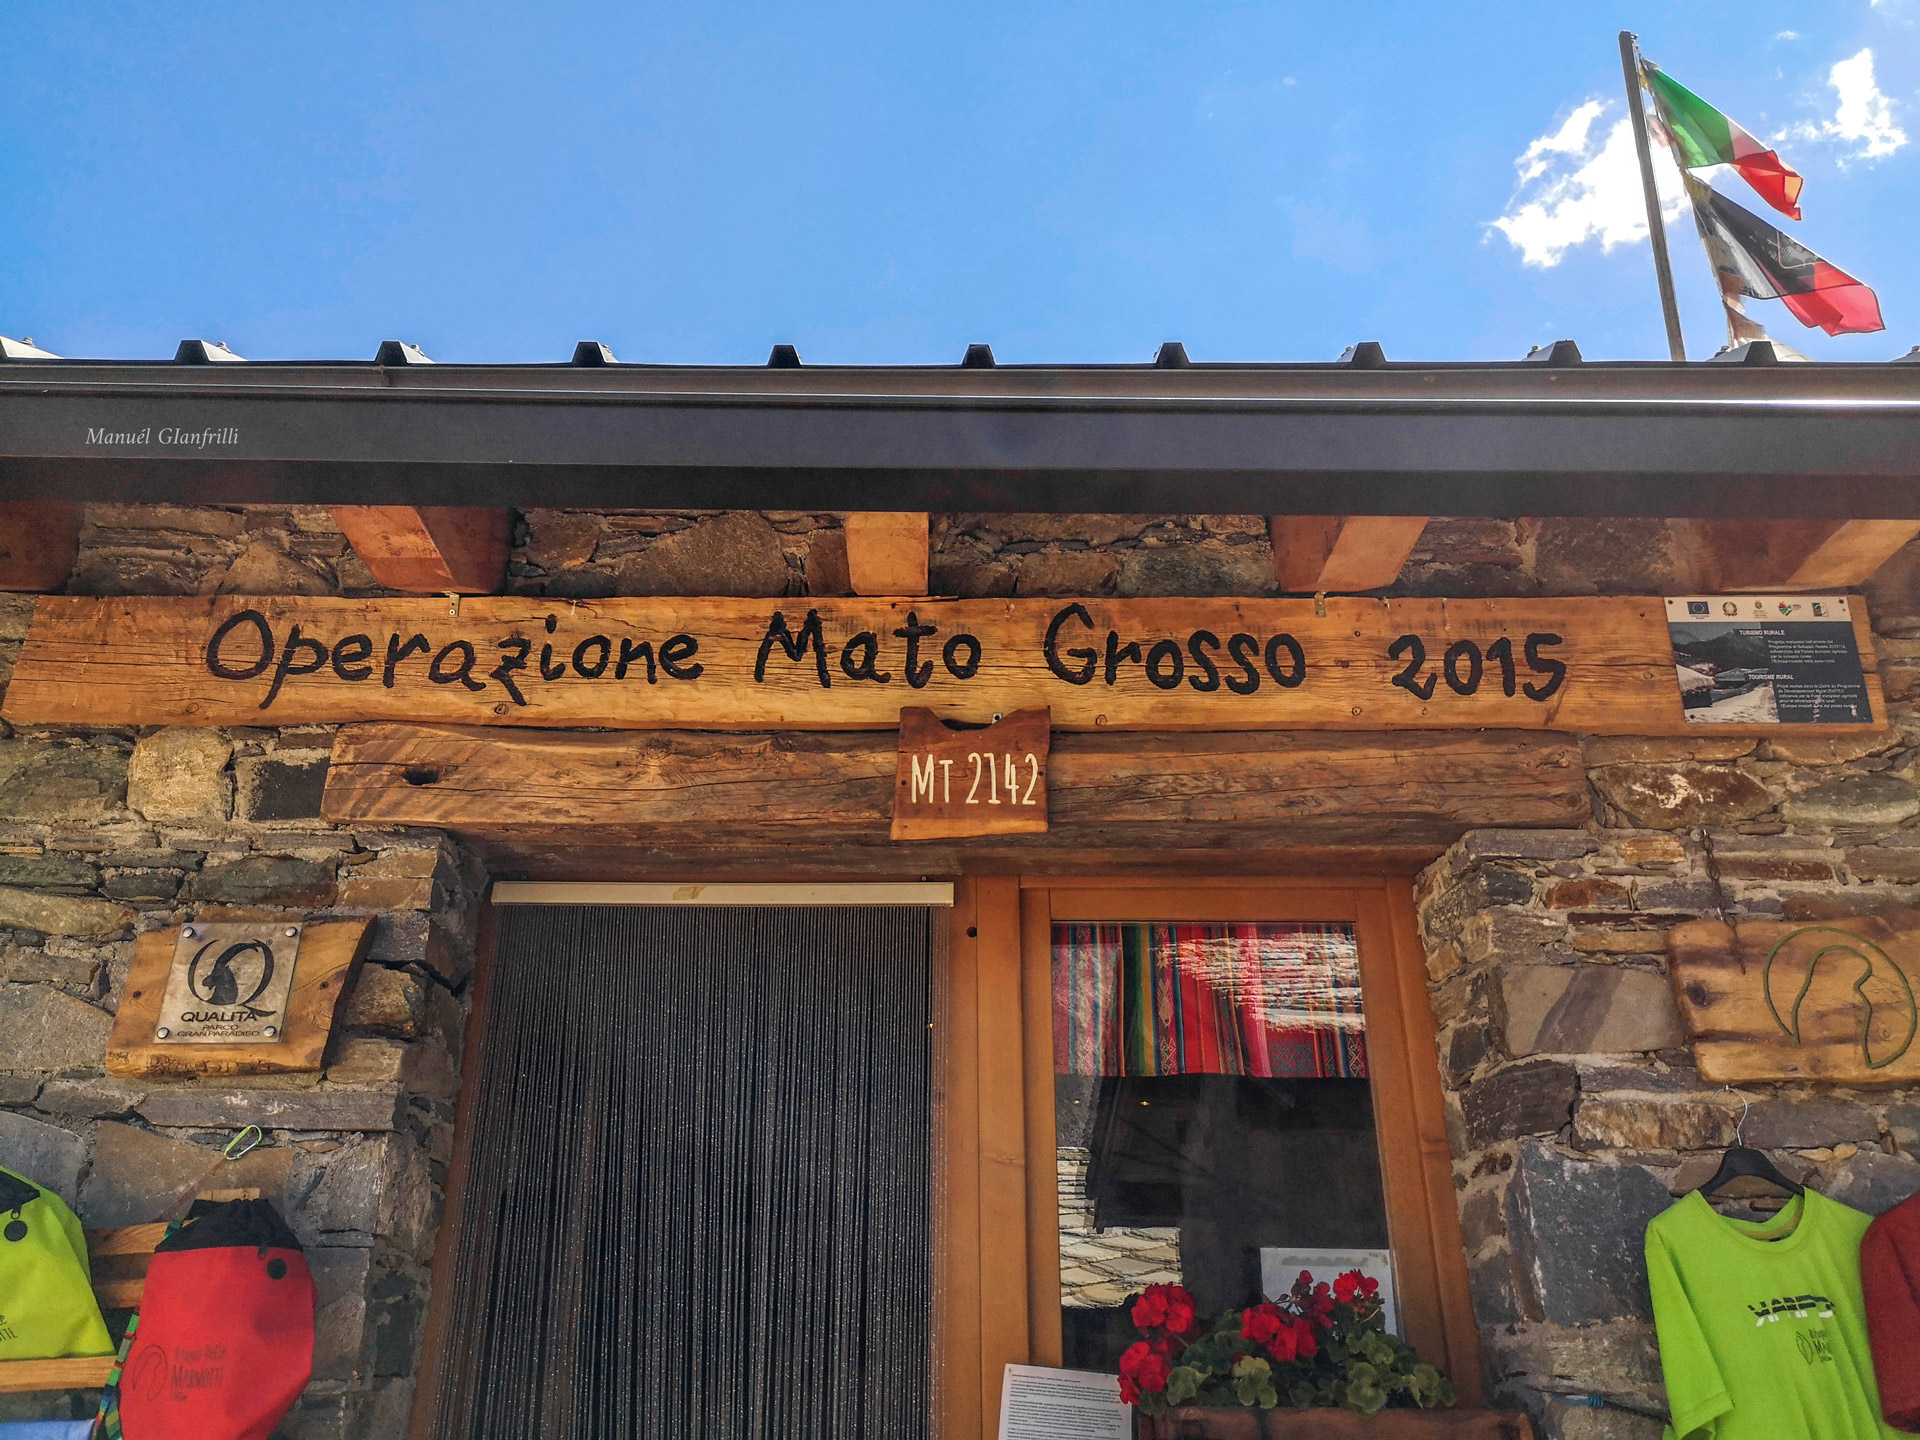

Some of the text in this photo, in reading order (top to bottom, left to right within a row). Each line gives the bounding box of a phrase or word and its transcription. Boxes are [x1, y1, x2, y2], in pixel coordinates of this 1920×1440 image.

[206, 602, 1568, 709] Operazione Mato Grosso 2015
[911, 752, 1039, 805] MT 2142
